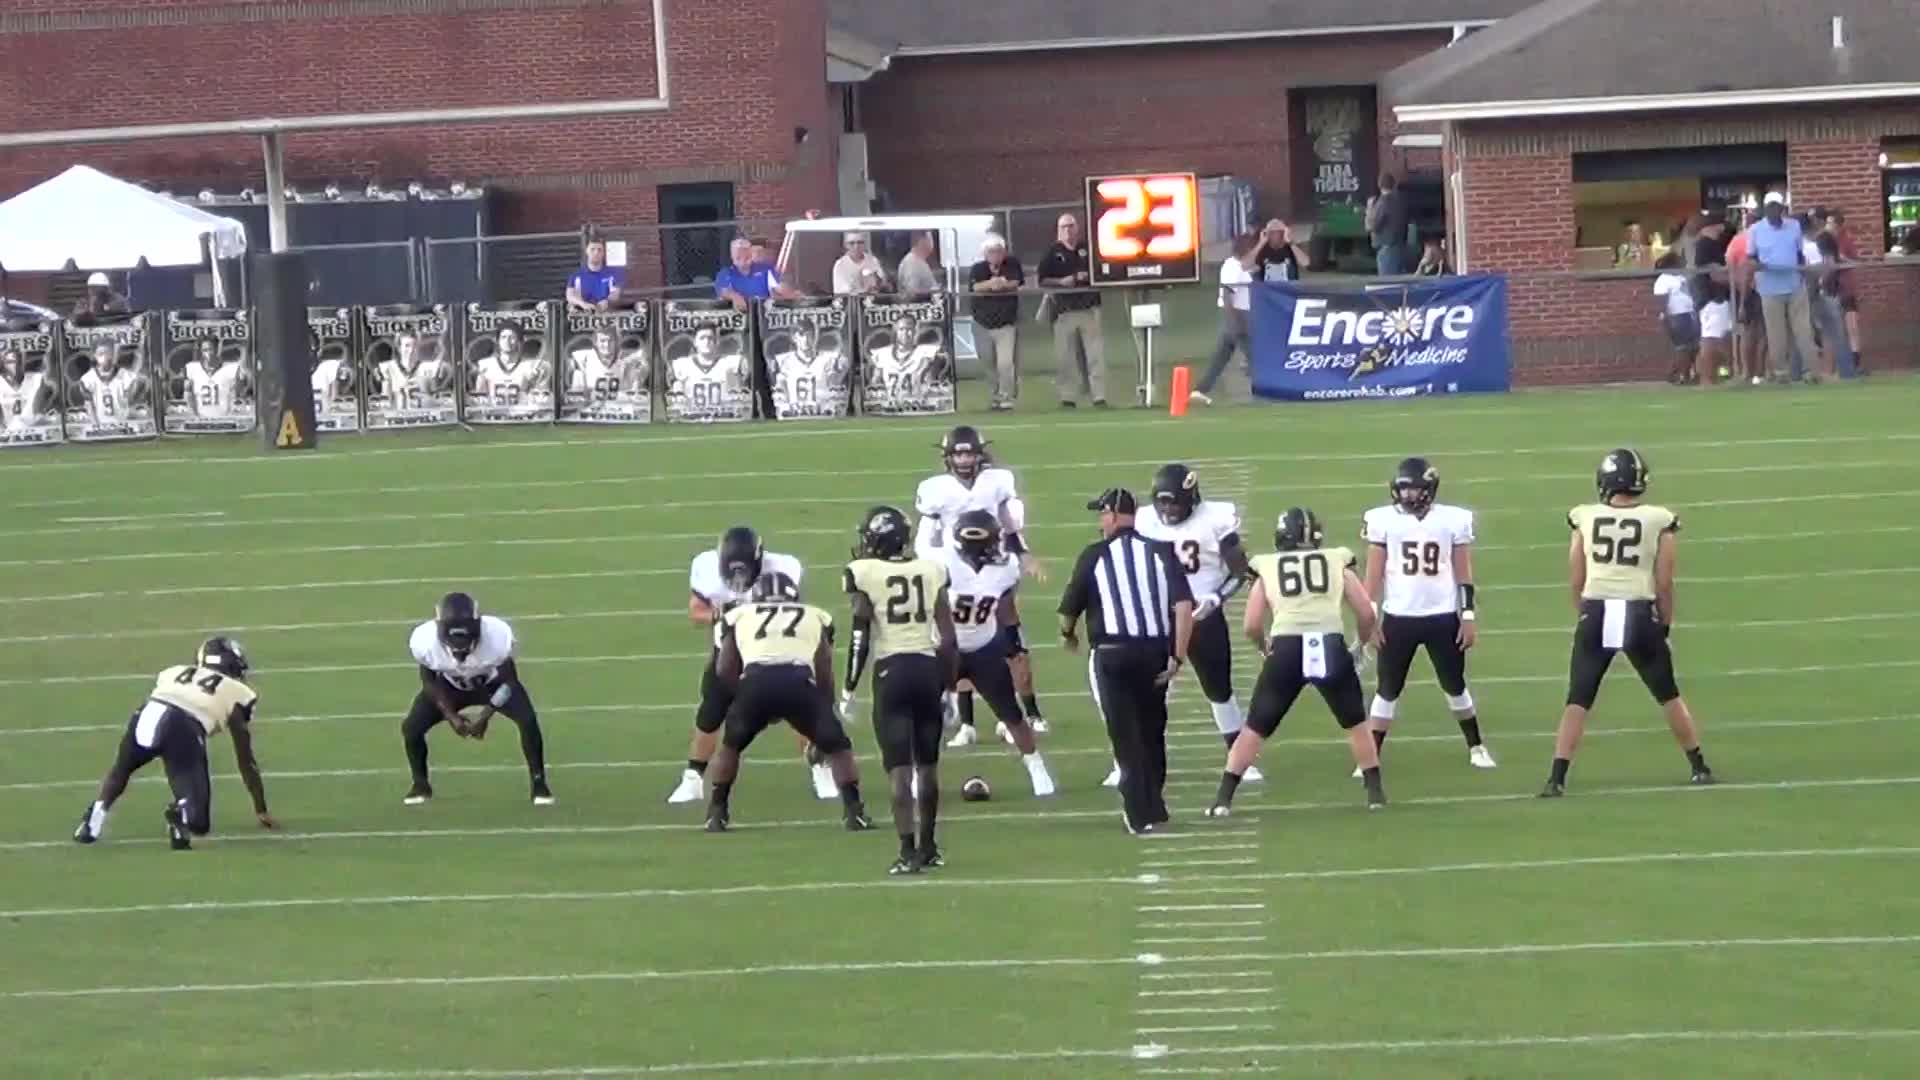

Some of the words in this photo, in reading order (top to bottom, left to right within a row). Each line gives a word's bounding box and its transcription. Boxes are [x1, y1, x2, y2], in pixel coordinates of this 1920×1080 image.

[1097, 178, 1192, 257] 23
[470, 314, 546, 332] TIGRS
[1285, 350, 1356, 375] Sports
[1385, 346, 1468, 366] Medicine
[200, 384, 219, 406] 21
[694, 382, 721, 406] 60
[796, 375, 816, 400] 61
[889, 373, 913, 397] 74
[276, 410, 302, 446] A
[1593, 517, 1642, 566] 52
[1181, 540, 1200, 575] 3
[1401, 541, 1440, 576] 59
[1278, 554, 1328, 597] 60
[886, 575, 927, 624] 21
[952, 594, 996, 624] 58
[754, 606, 805, 639] 77
[175, 667, 223, 696] 44
